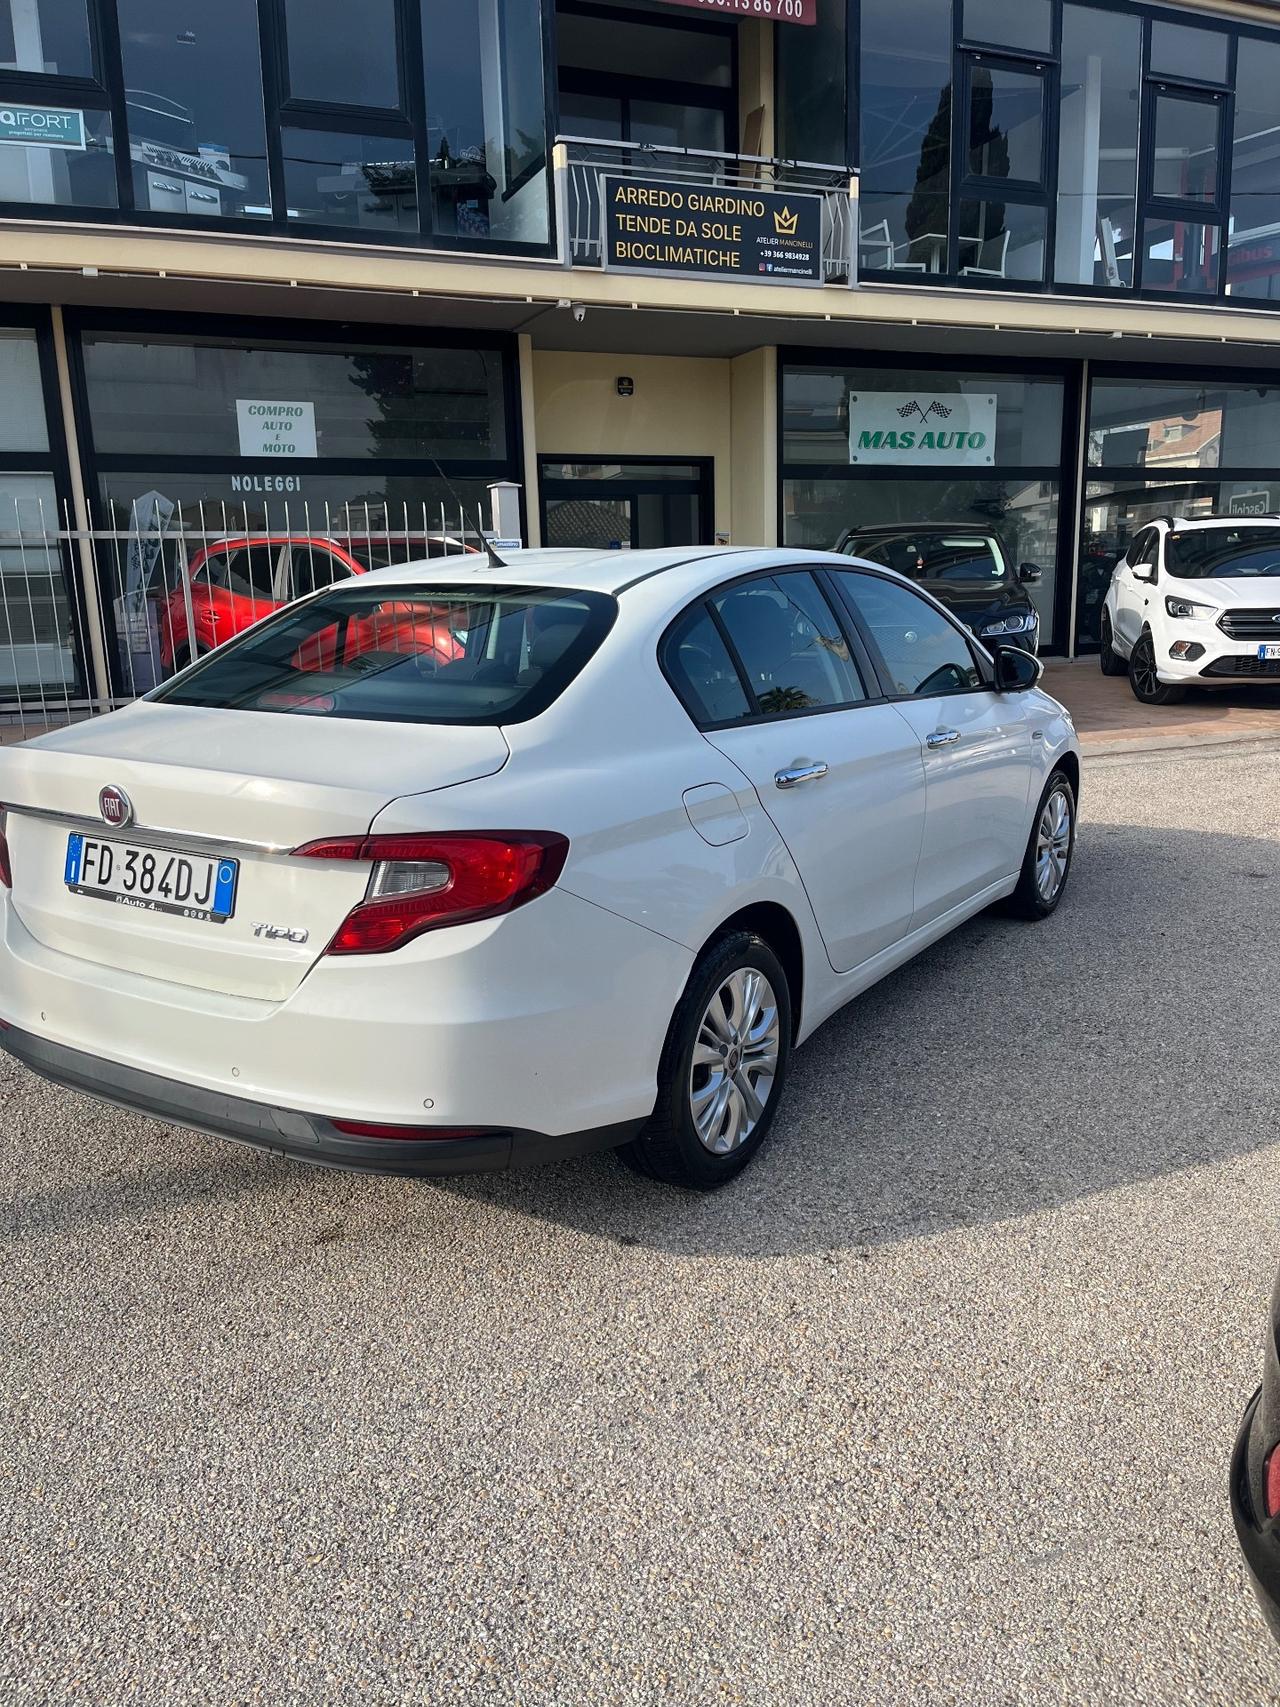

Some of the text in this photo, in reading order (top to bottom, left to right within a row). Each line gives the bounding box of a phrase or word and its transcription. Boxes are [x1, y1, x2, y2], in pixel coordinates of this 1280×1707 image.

[753, 0, 772, 13] 86
[777, 0, 803, 17] 700
[615, 186, 765, 217] ARREDO GIARDINO
[615, 214, 742, 242] TENDE DA SOLE
[756, 236, 814, 249] ATELIER MANCINELLI
[616, 241, 741, 268] BIOCLIMATICHE
[760, 250, 810, 261] +39 366 9834928
[248, 405, 304, 417] COMPRO
[262, 421, 293, 431] AUTO
[275, 433, 281, 441] E
[858, 430, 986, 451] MAS AUTO
[262, 443, 296, 453] MOTO
[231, 475, 301, 492] NOLEGGI
[103, 797, 120, 818] FIAT
[81, 842, 114, 885] FD
[123, 850, 213, 905] 384DJ
[251, 920, 309, 943] TIPO
